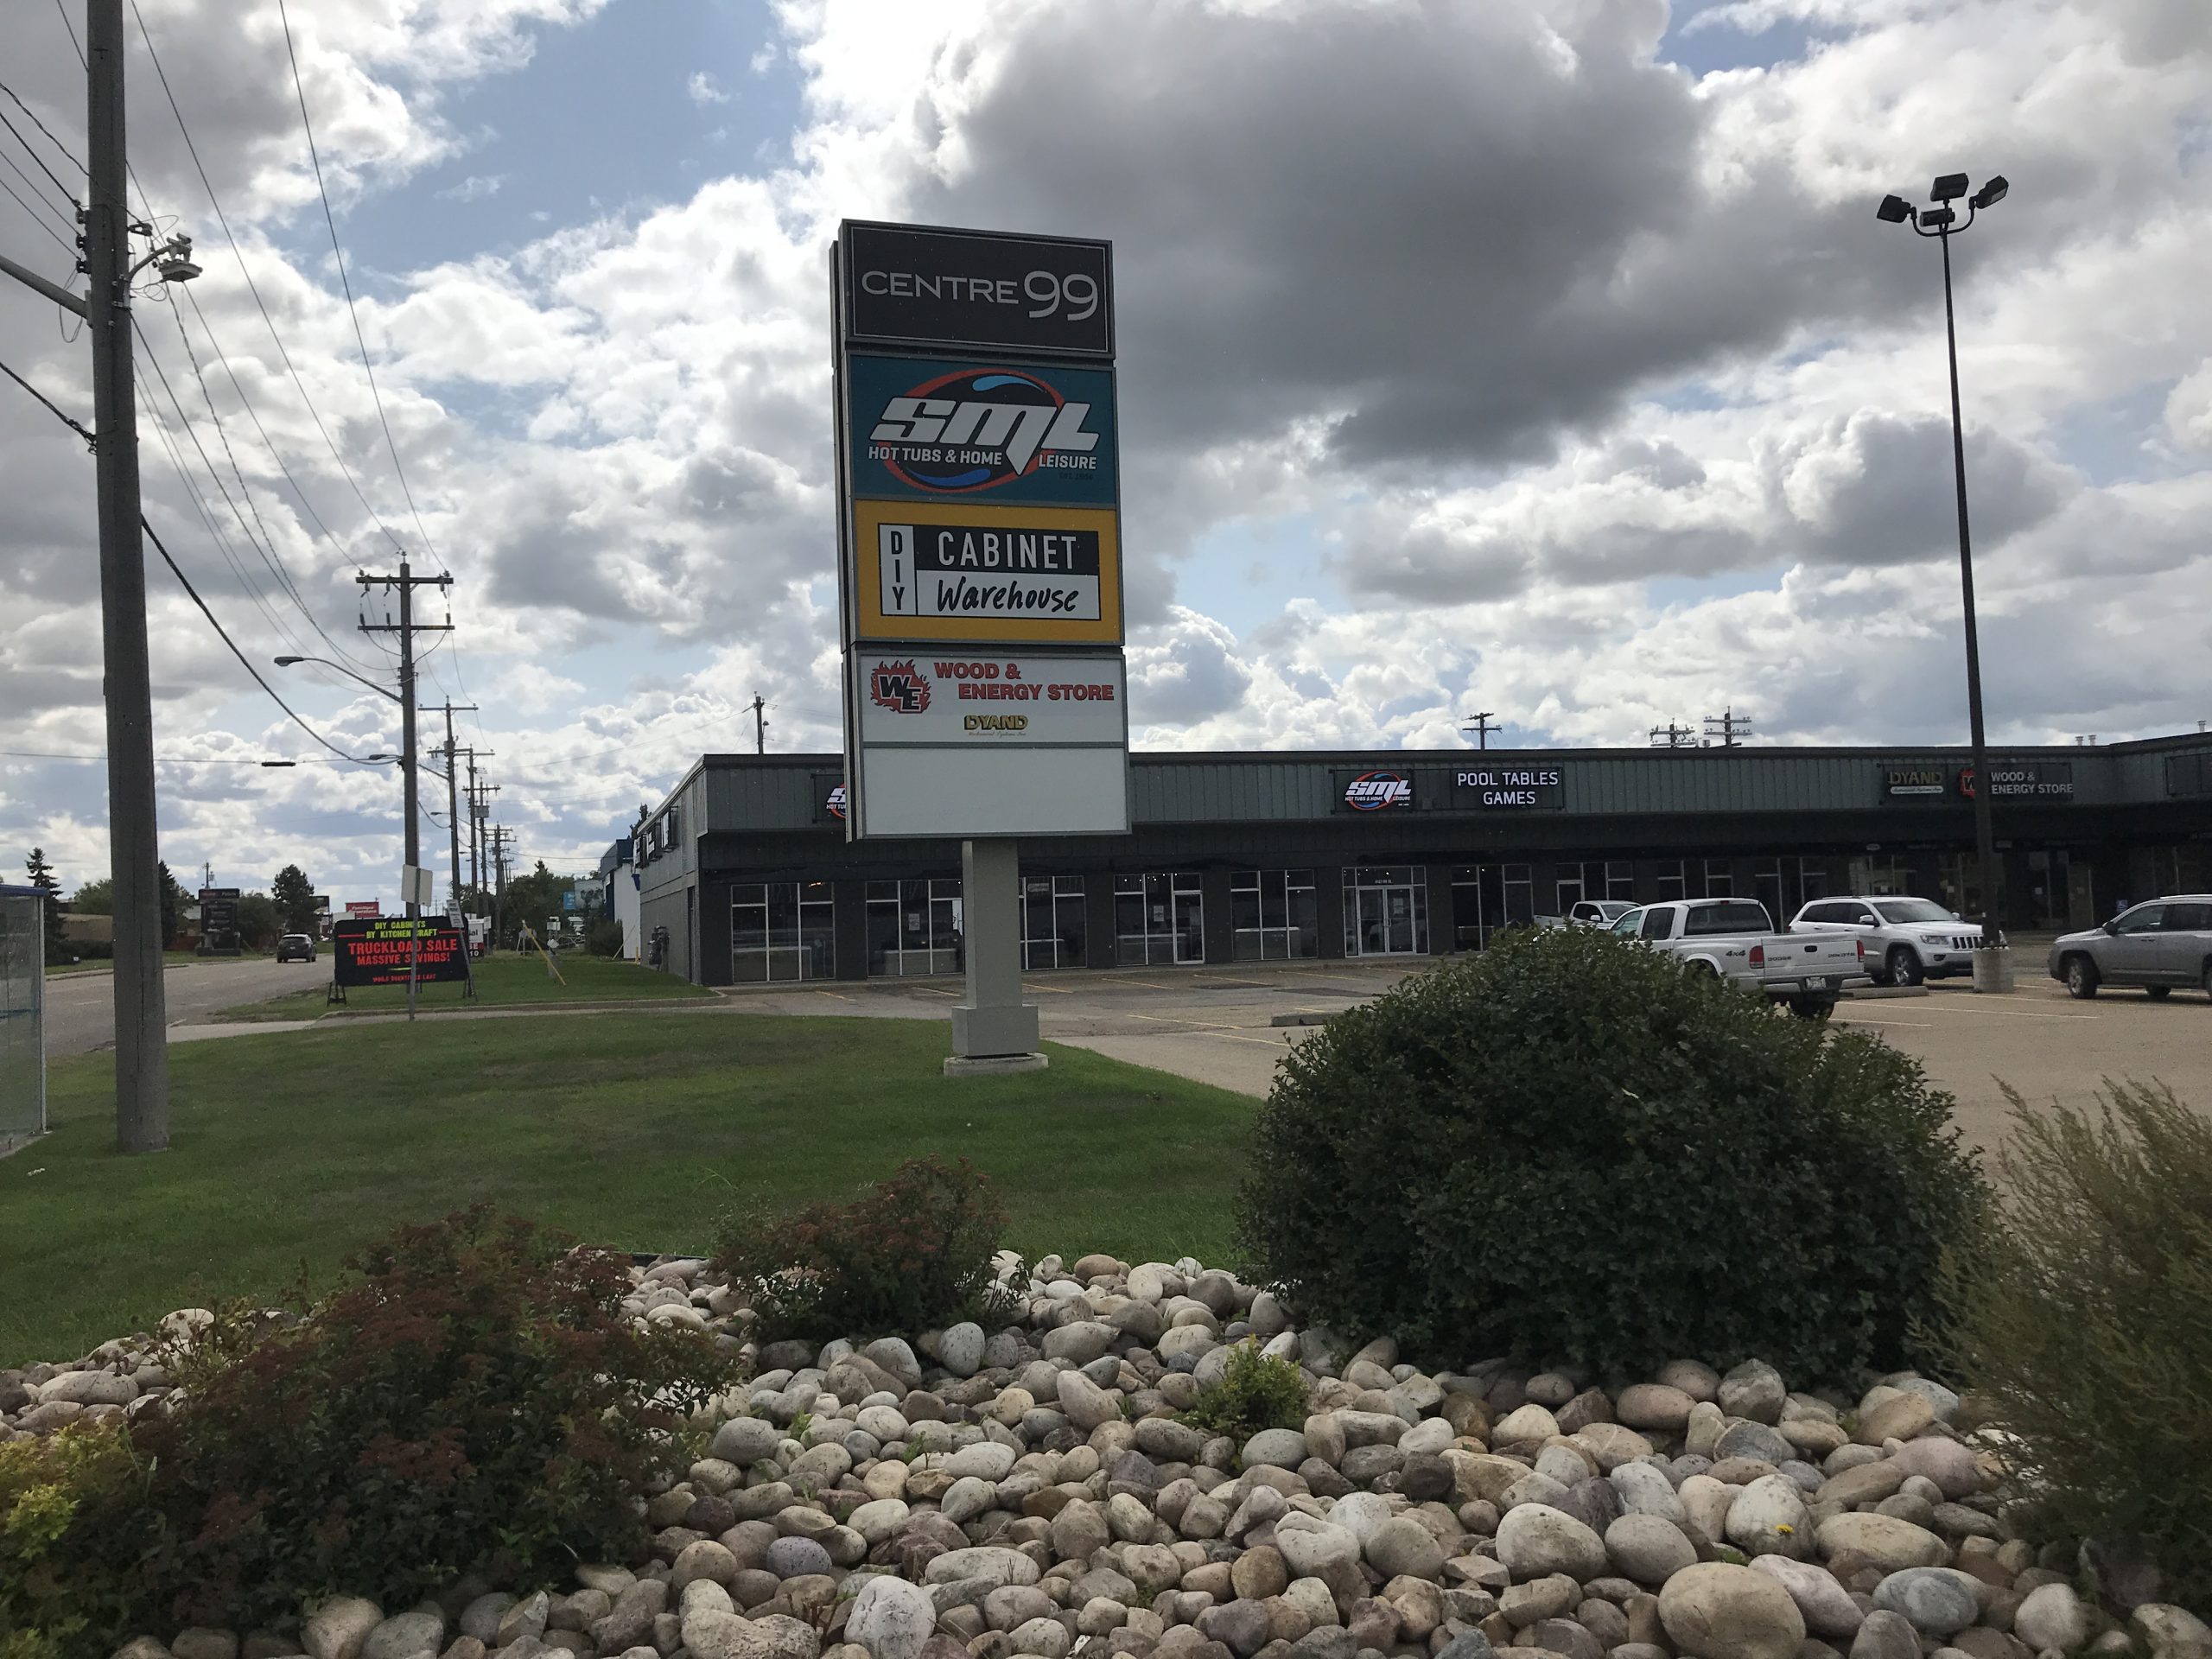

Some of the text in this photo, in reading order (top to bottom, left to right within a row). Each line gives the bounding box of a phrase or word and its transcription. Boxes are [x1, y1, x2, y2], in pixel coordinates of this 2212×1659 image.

[861, 270, 1099, 321] CENTRE 99
[868, 446, 1097, 470] HOT TUBS & HOME LEISURE
[938, 531, 1077, 570] CABINET
[936, 575, 1079, 613] Warehouse
[933, 662, 1021, 679] WOOD &
[958, 683, 1115, 702] ENERGY STORE
[964, 715, 1028, 730] DYAND
[1457, 772, 1559, 786] POOL TABLES
[1991, 772, 2036, 782] WOOD &
[1991, 783, 2073, 795] ENERGY STORE
[1483, 791, 1535, 805] GAMES
[374, 921, 387, 930] DIY
[365, 931, 376, 939] BY
[380, 929, 411, 938] KITCHEN
[426, 938, 457, 951] SALE
[356, 952, 450, 966] MASSIVE SVINGS!
